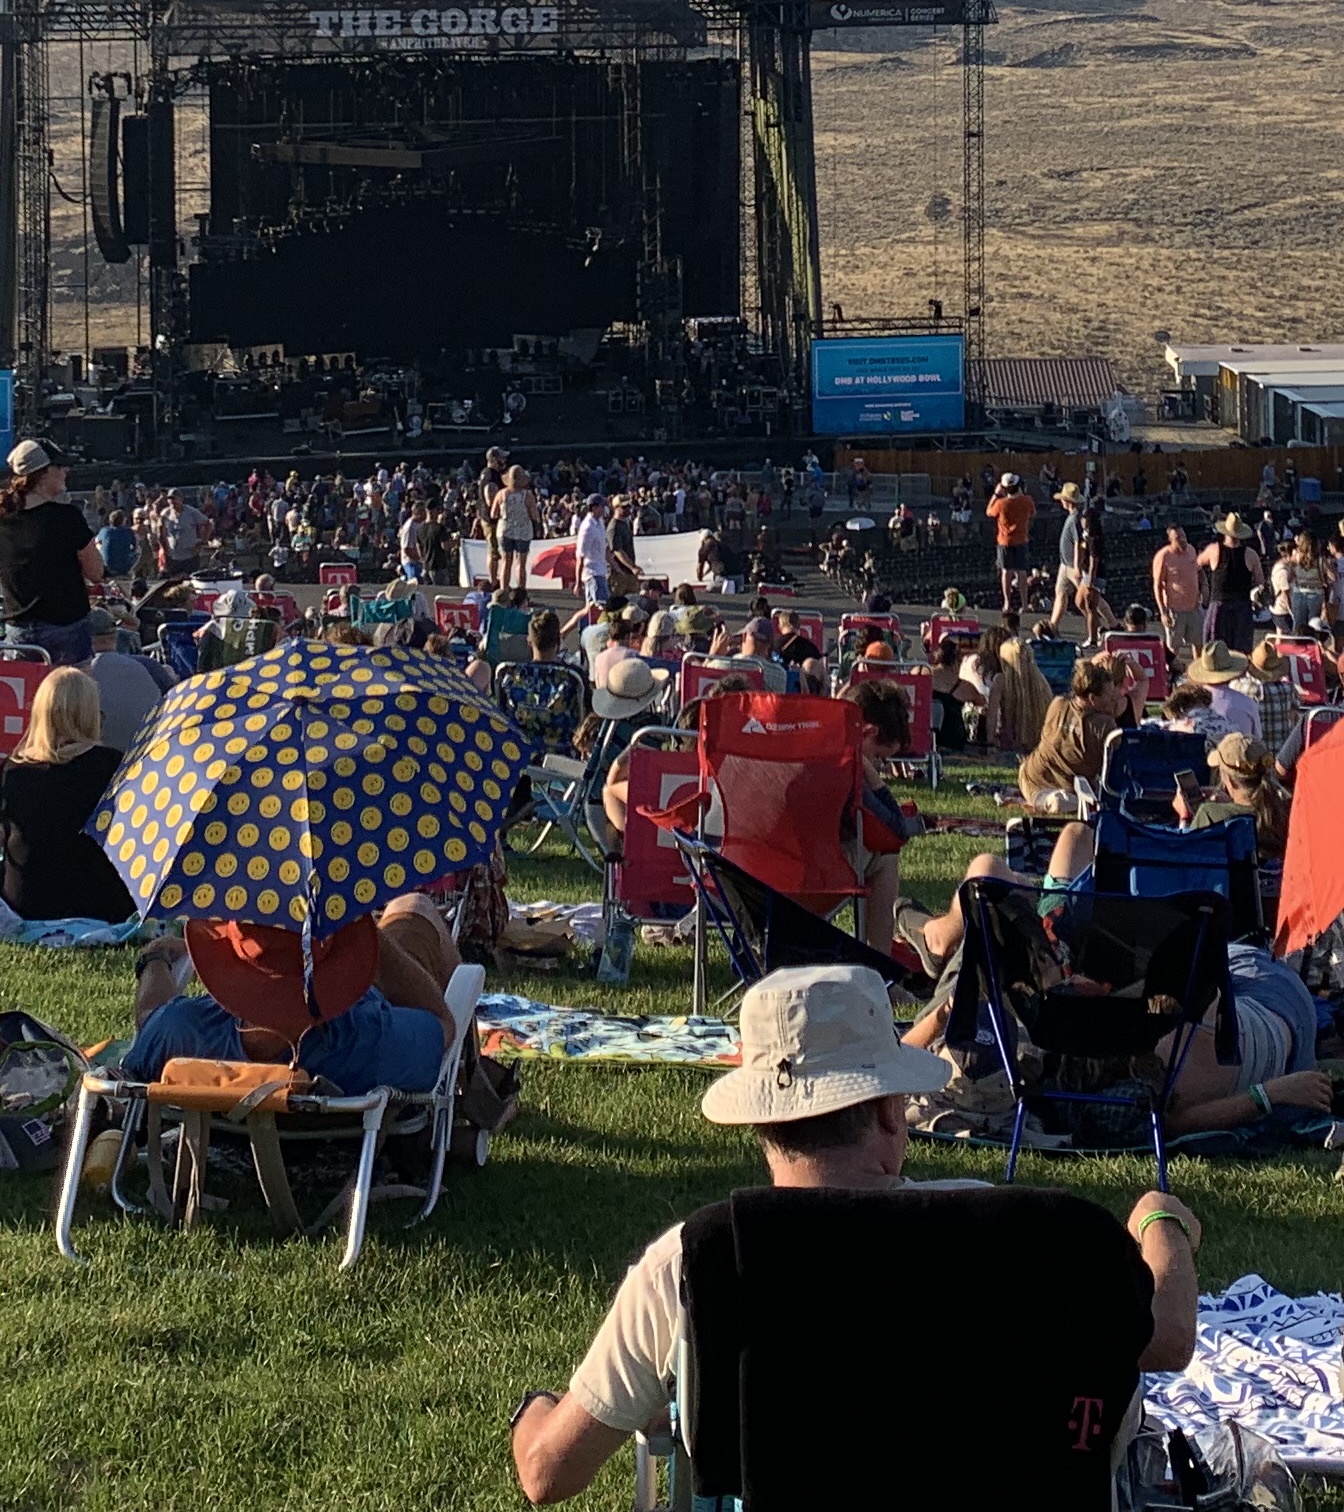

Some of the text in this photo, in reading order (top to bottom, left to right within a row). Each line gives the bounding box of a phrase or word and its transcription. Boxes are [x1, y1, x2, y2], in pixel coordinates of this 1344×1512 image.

[852, 7, 902, 18] NUMERICA
[910, 7, 945, 15] CONCERT
[309, 6, 558, 37] THE GORGE
[854, 376, 865, 384] AT
[866, 374, 917, 384] HOLLYWOOD
[918, 373, 942, 382] BOWL
[1068, 1396, 1104, 1452] T
